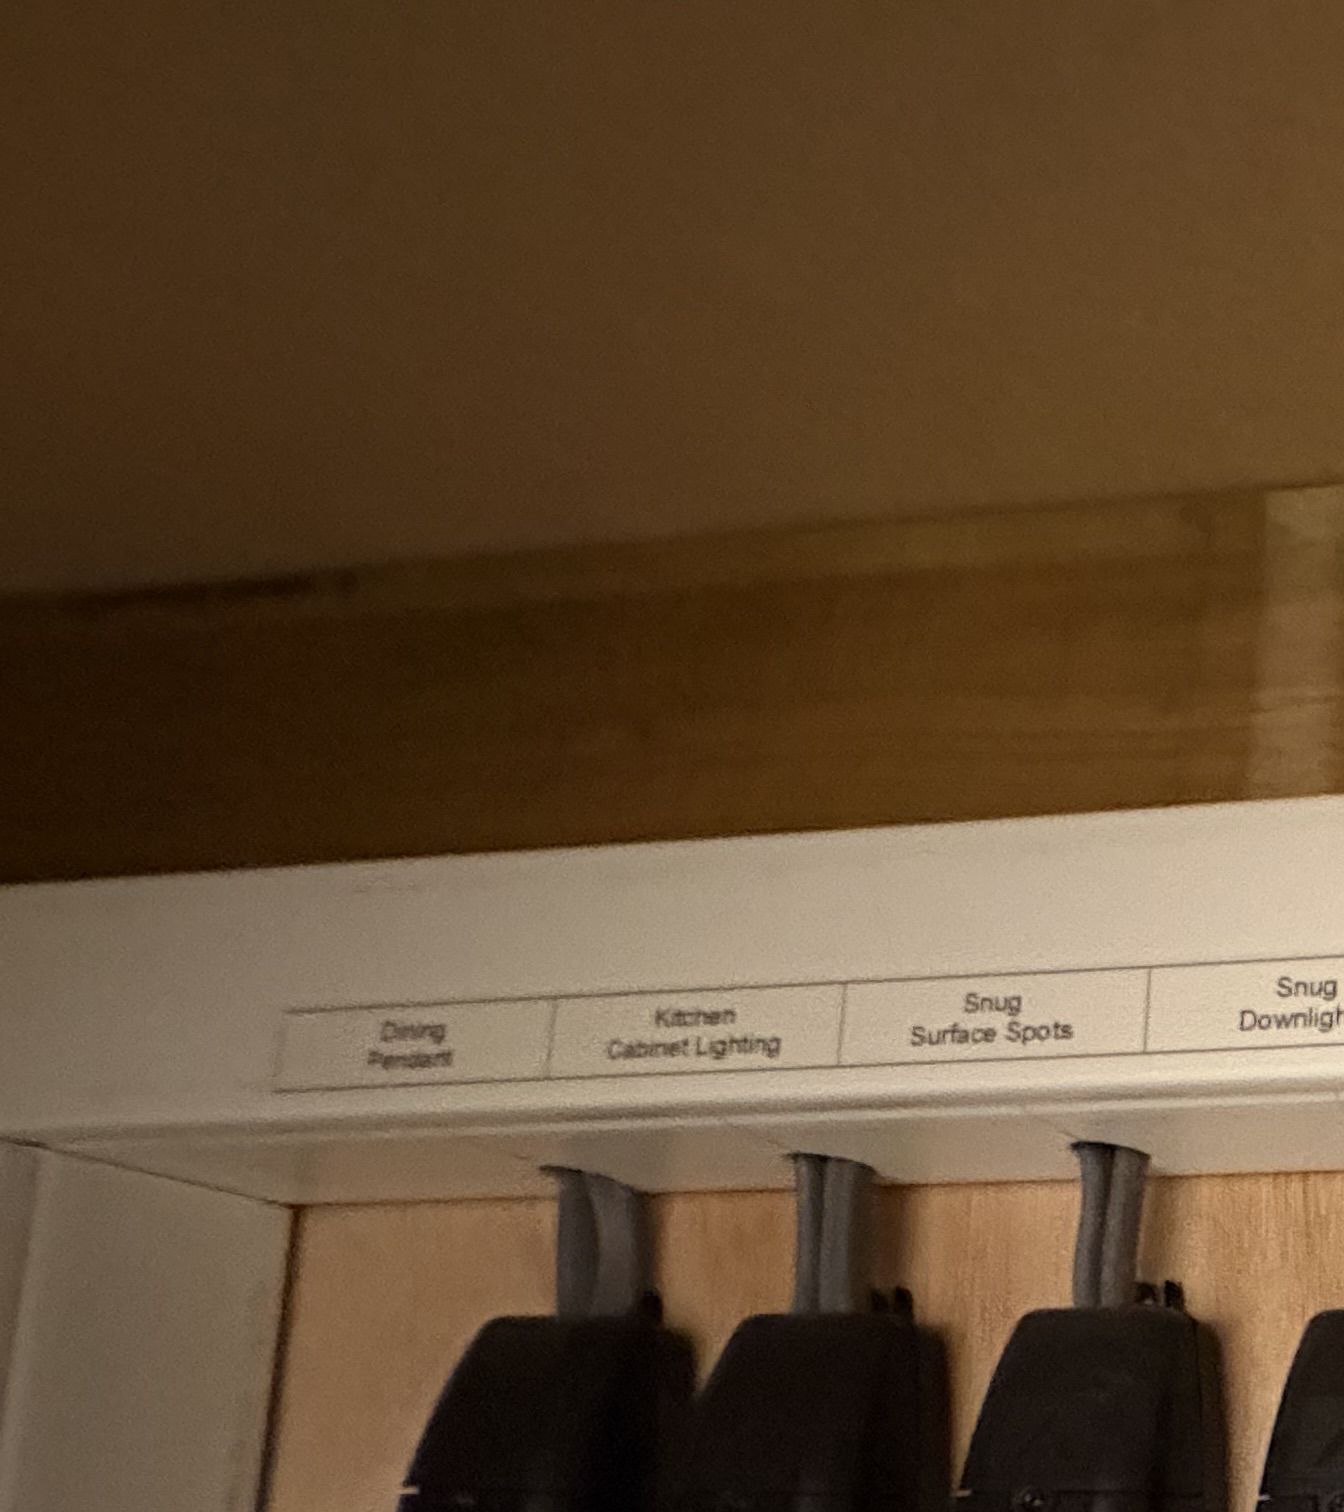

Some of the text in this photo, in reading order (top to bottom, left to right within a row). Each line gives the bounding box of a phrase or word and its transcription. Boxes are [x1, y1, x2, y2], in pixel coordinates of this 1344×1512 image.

[1276, 975, 1338, 1000] Snug
[963, 991, 1022, 1016] Snug
[654, 1005, 735, 1029] Kitchen
[380, 1019, 446, 1046] Dining
[909, 1018, 1074, 1047] Surface Spots
[606, 1031, 781, 1061] Cabinet Lighting
[368, 1048, 454, 1073] Pendant
